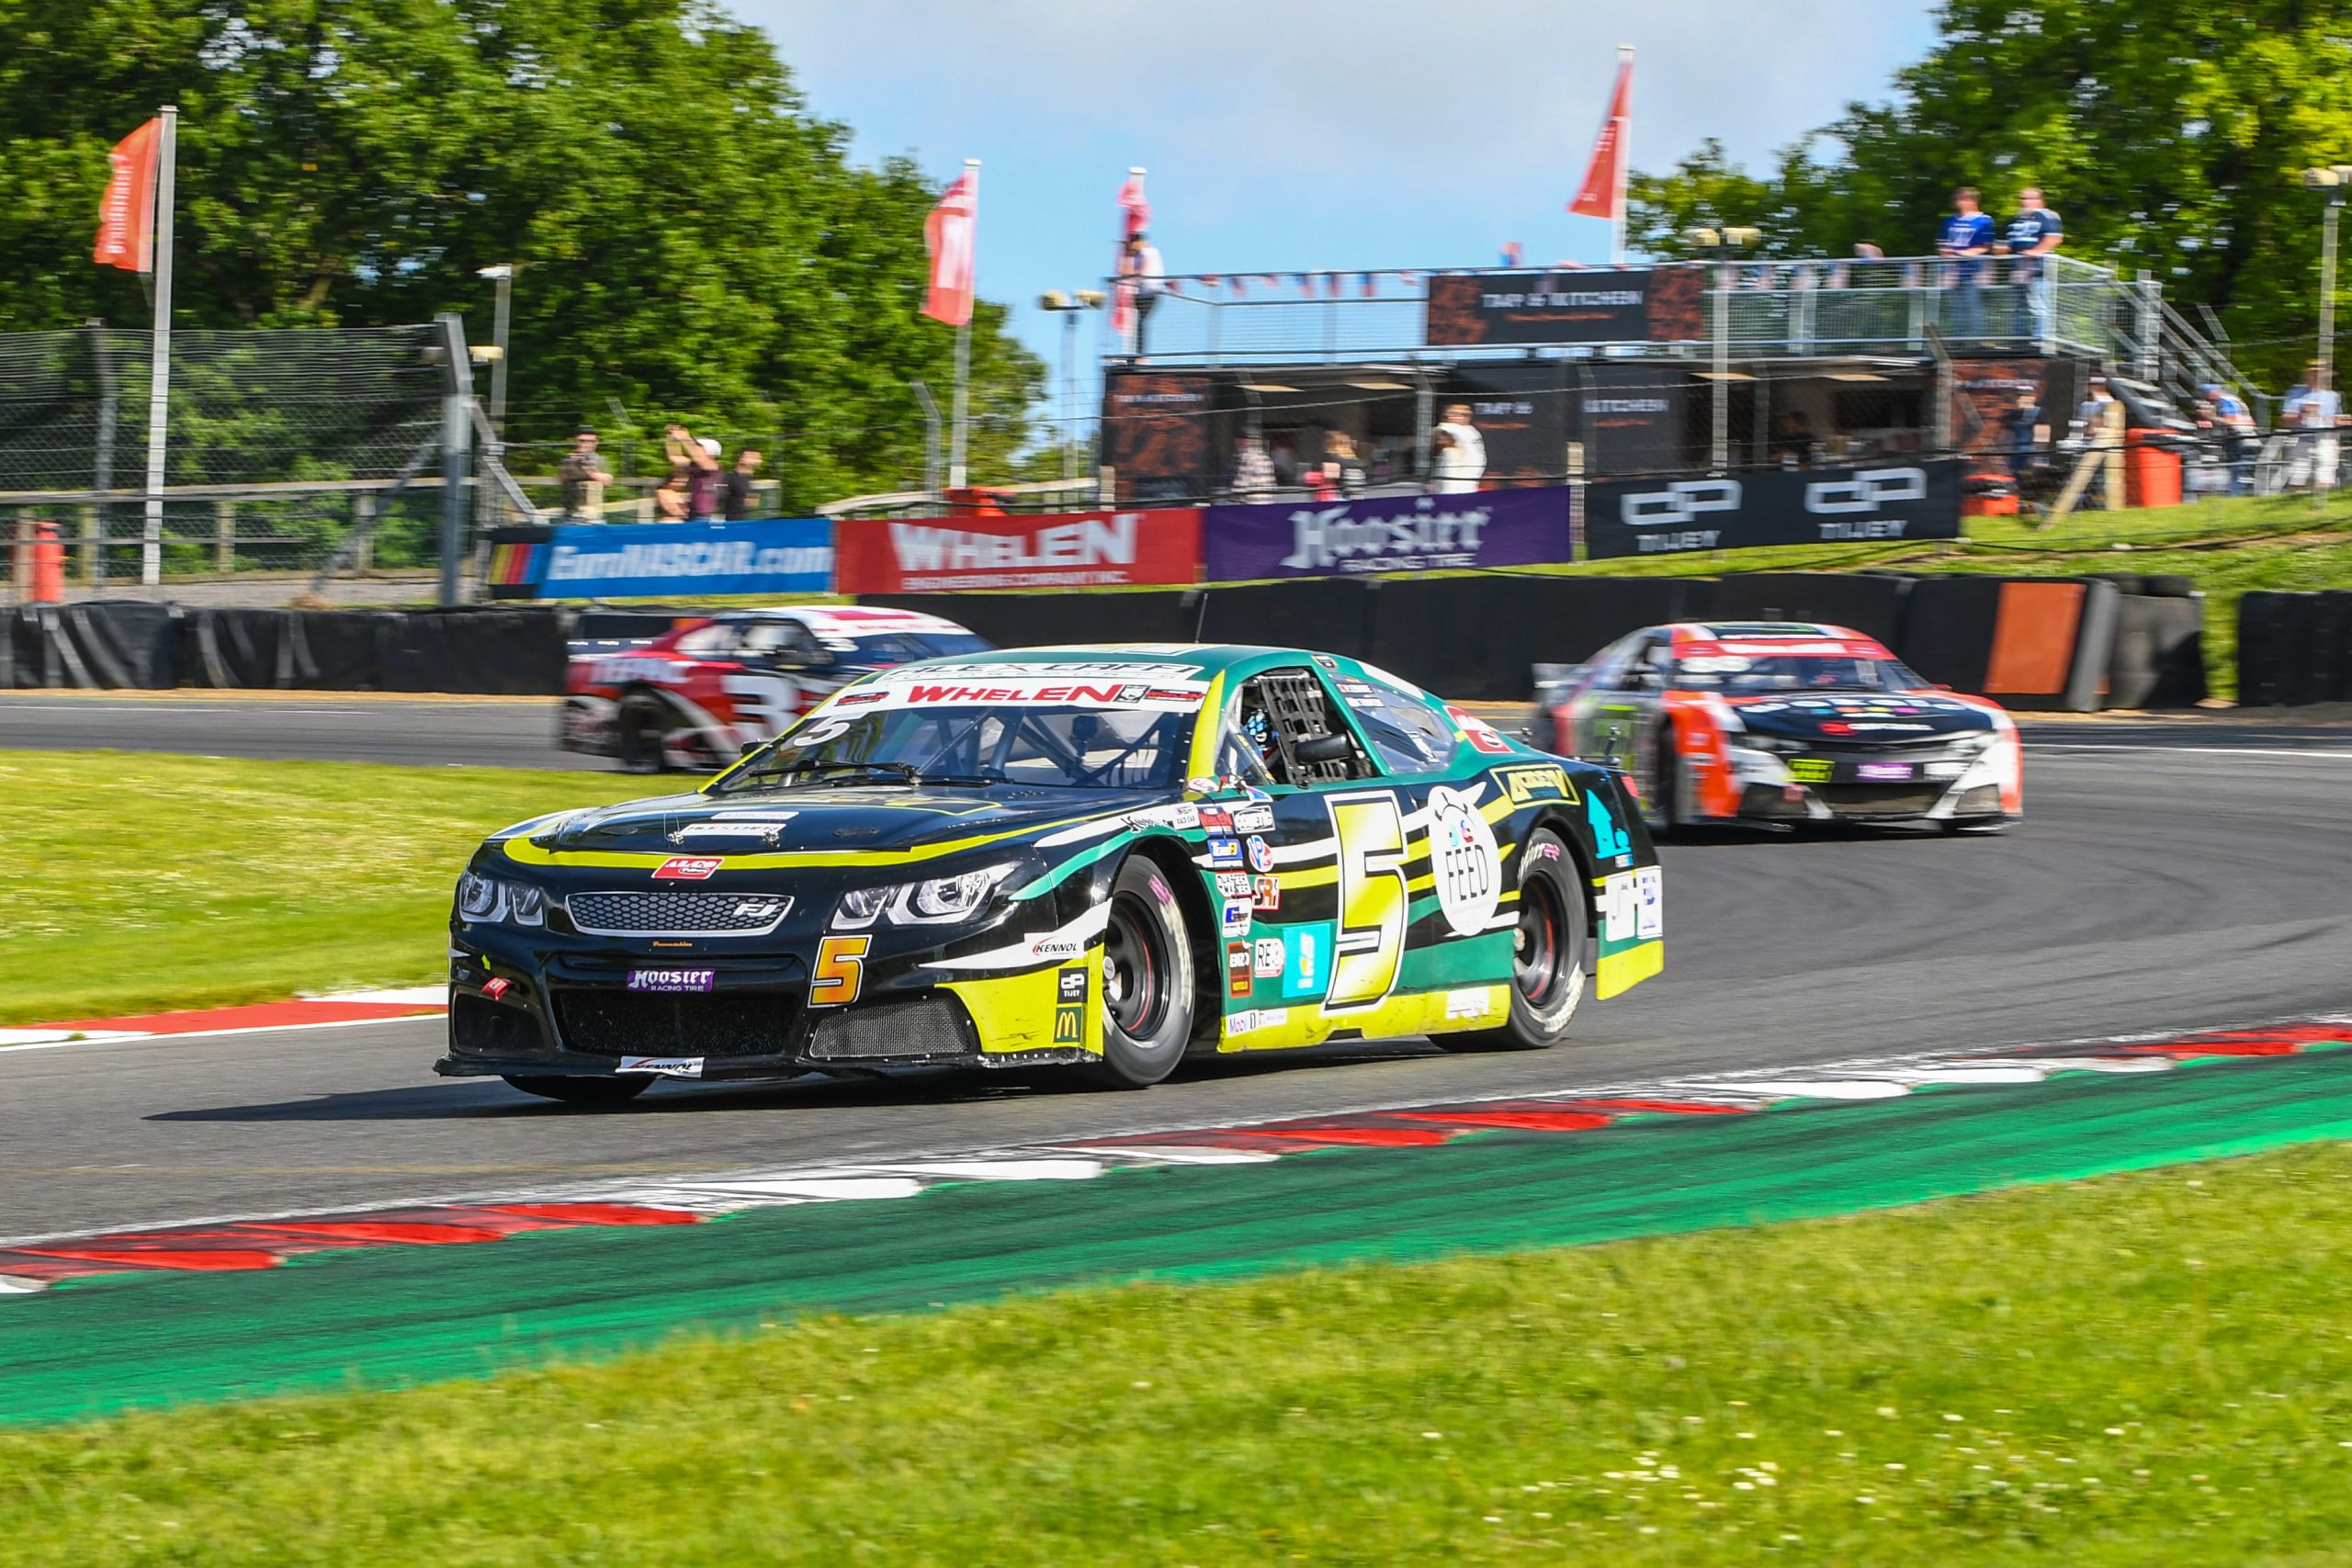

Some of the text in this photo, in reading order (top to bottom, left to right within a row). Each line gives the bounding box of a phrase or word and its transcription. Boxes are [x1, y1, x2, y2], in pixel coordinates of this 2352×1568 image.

[888, 513, 1140, 571] WHELEN
[908, 684, 1123, 704] WHELEN
[794, 711, 869, 746] 5
[1445, 844, 1489, 905] FEED
[1320, 790, 1408, 1017] 5
[1035, 942, 1077, 953] KENNOL
[628, 970, 714, 989] Hoosier
[808, 934, 873, 1009] 5
